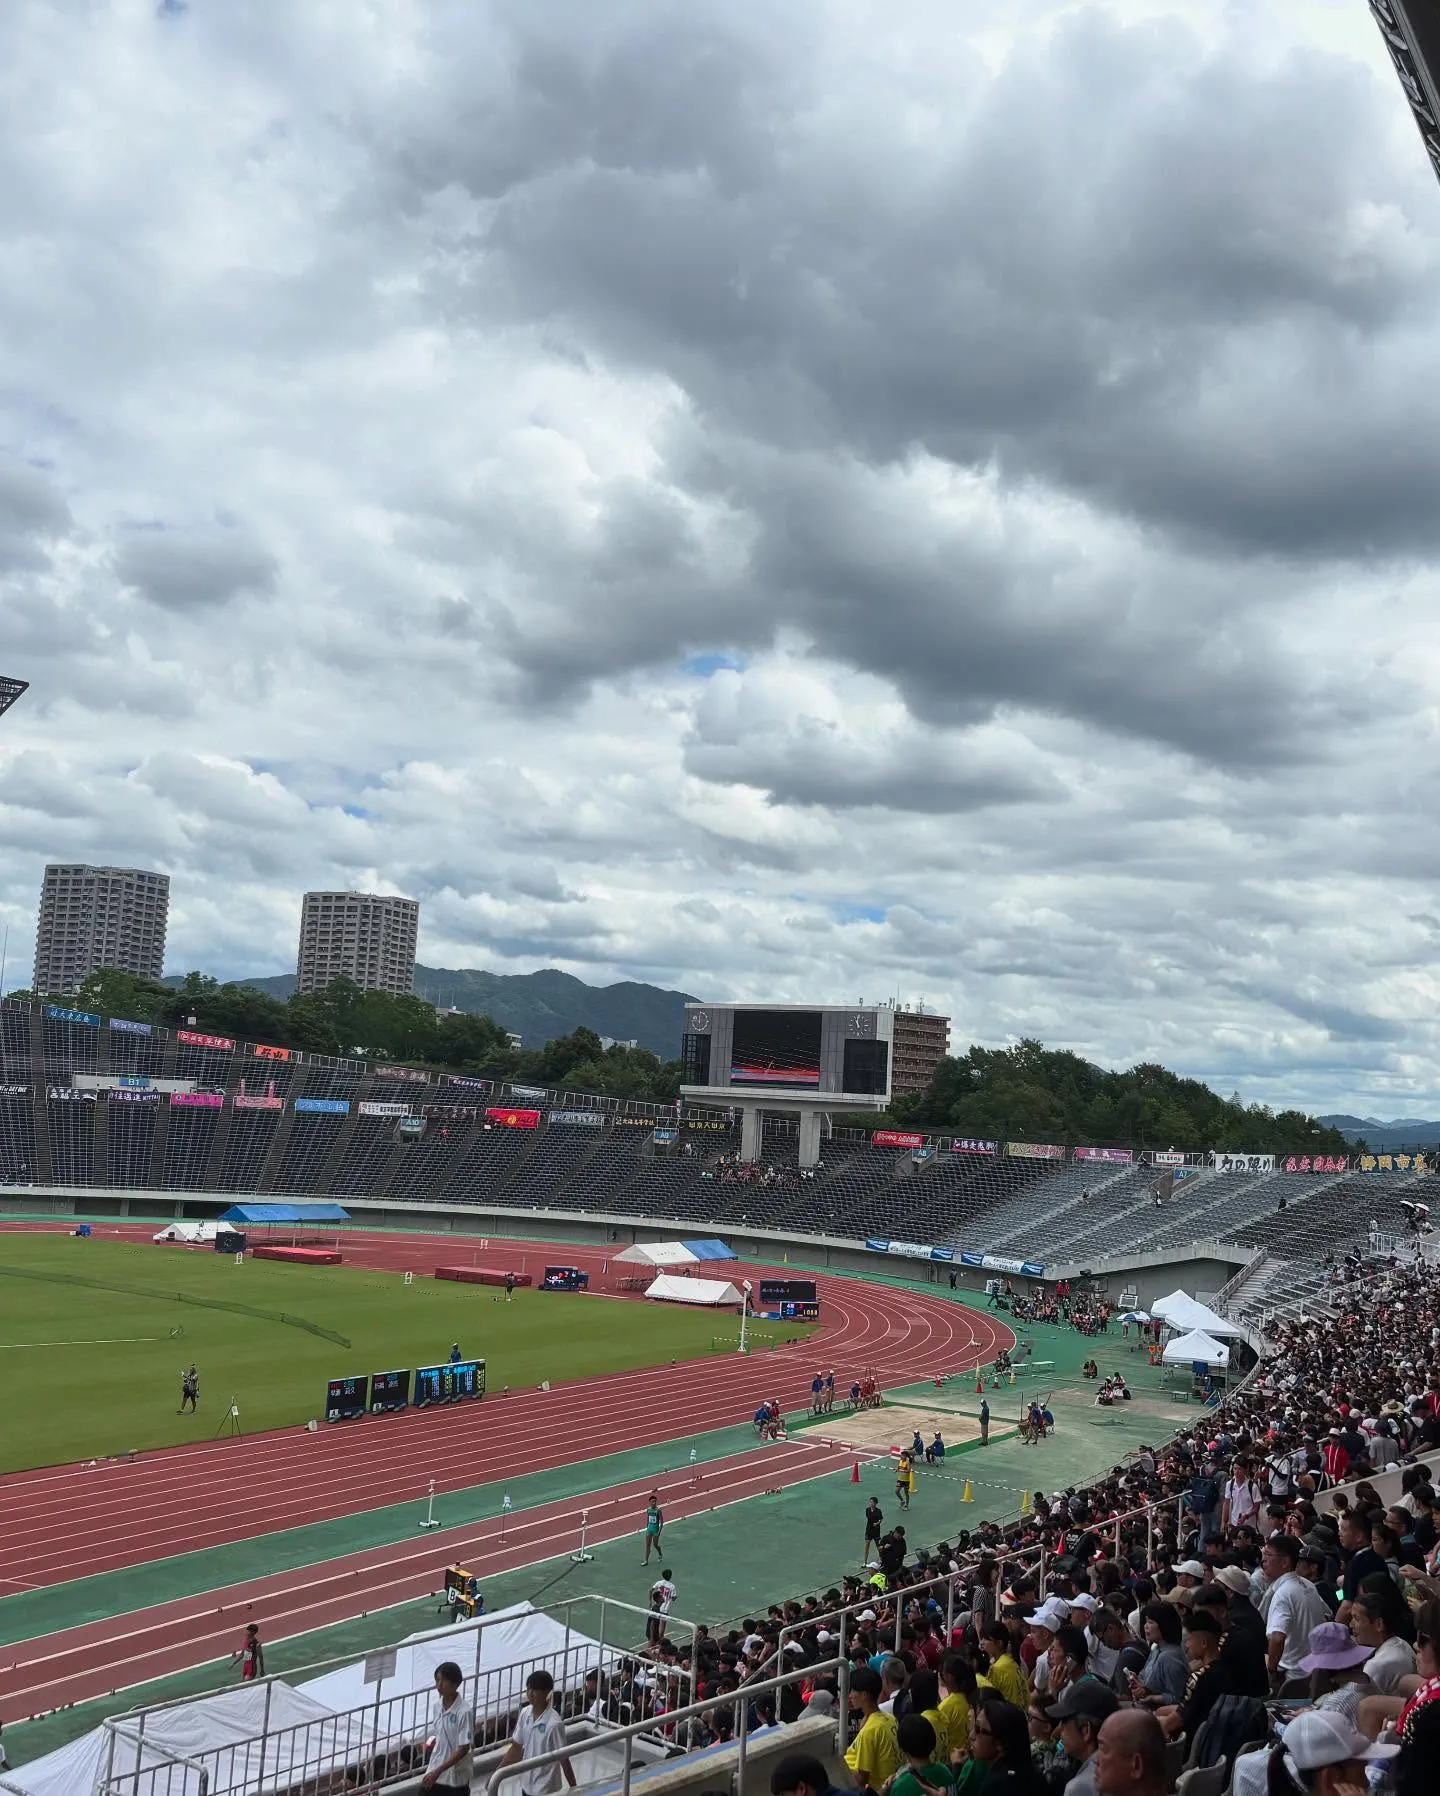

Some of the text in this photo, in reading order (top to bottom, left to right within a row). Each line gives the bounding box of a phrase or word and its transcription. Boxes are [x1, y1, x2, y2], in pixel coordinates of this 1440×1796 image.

[128, 1078, 140, 1086] B1
[1217, 1154, 1272, 1173] 力の限り
[449, 1590, 456, 1601] B
